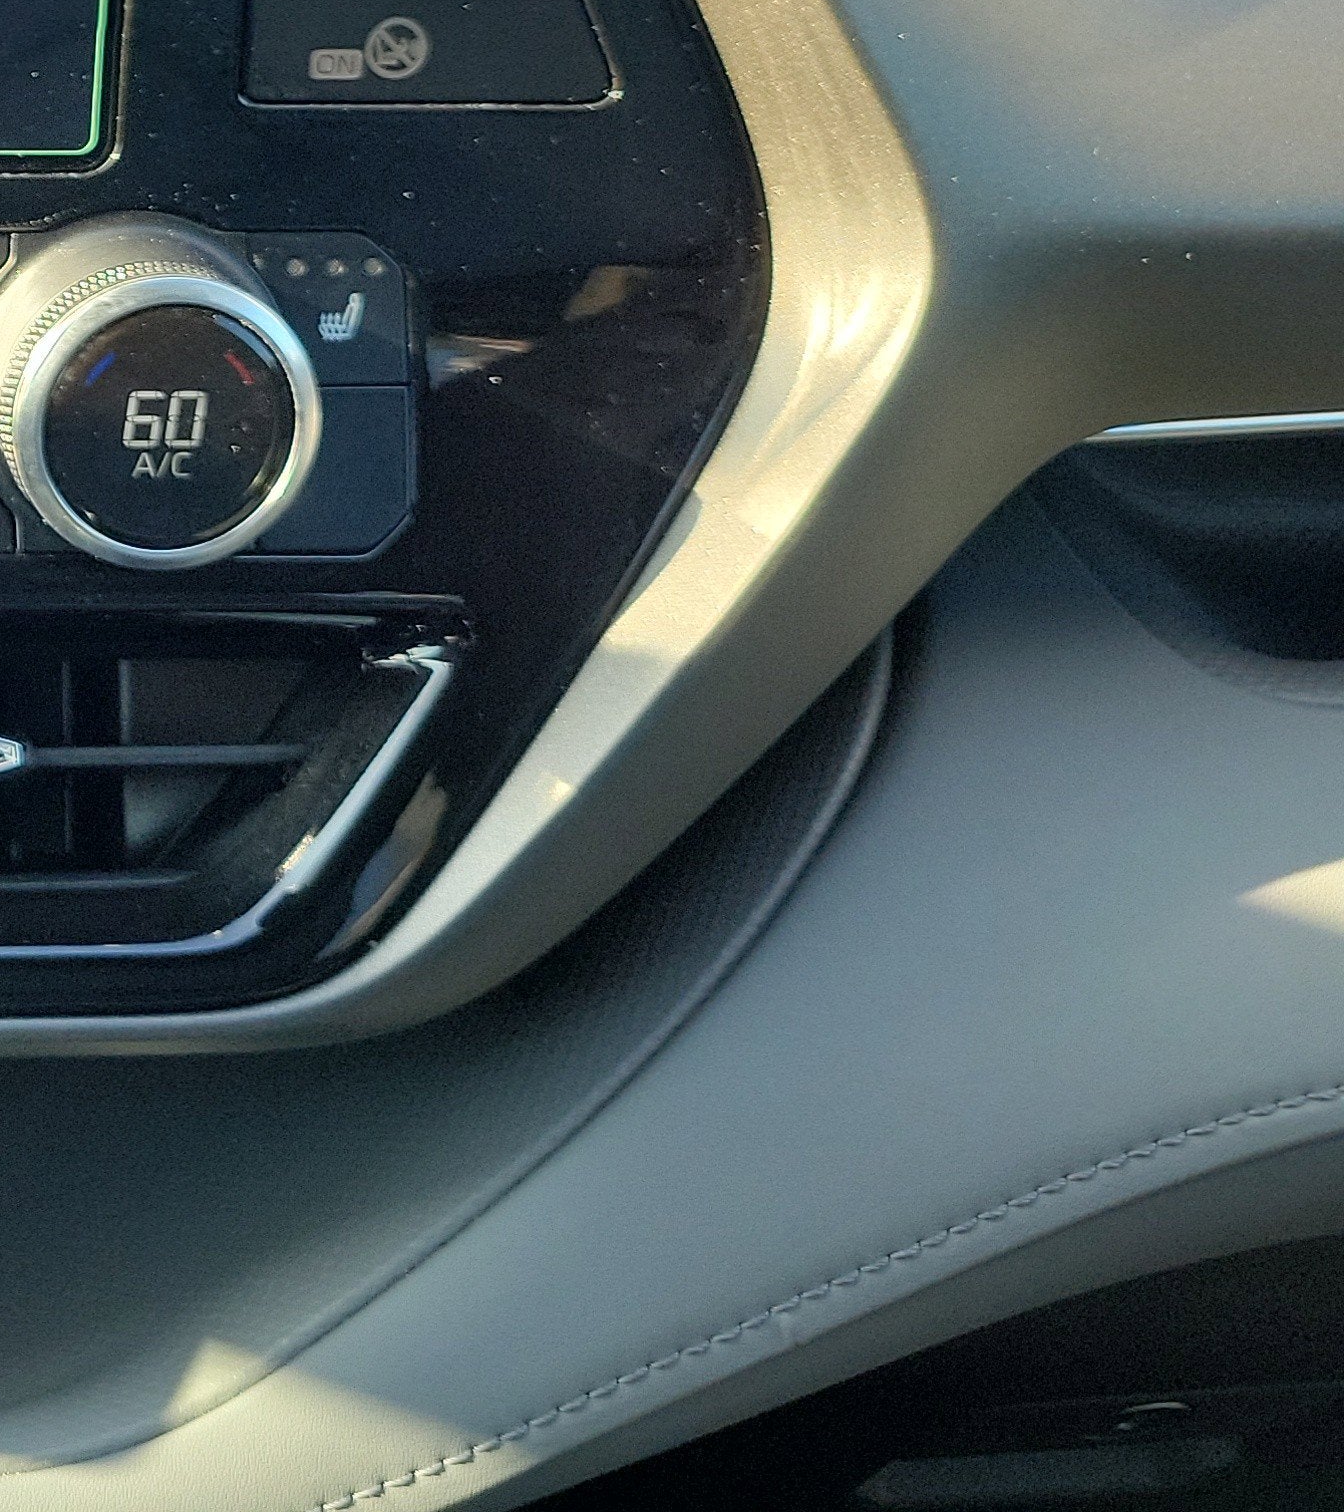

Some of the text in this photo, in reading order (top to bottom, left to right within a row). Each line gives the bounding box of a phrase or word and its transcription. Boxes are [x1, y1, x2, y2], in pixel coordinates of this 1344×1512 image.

[315, 53, 358, 76] ON
[121, 390, 210, 451] 60
[131, 452, 193, 480] A/C
